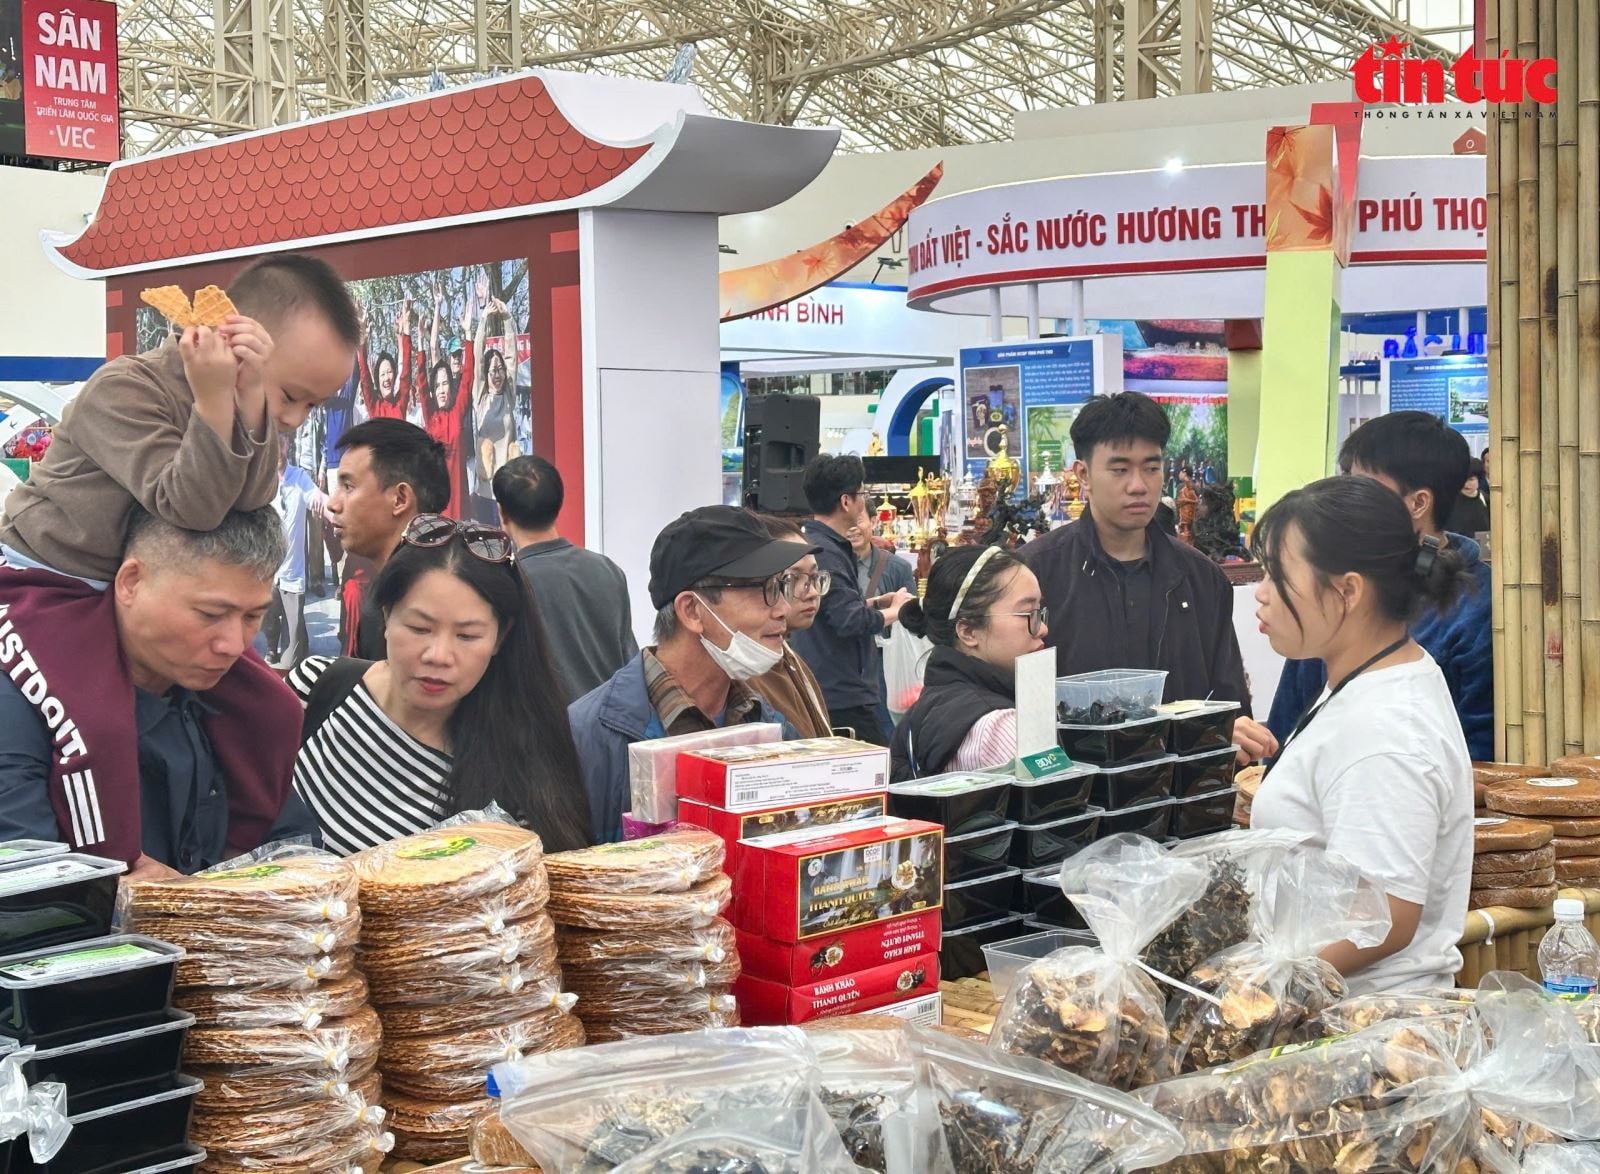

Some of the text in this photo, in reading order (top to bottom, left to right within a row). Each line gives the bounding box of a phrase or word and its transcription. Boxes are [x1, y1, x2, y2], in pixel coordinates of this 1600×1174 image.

[38, 8, 101, 51] SÂN
[35, 54, 107, 95] NAM
[53, 96, 79, 108] TRUNG
[55, 124, 96, 149] VEC
[941, 224, 971, 268] VIỆT
[987, 211, 1029, 256] SẮC
[1036, 208, 1107, 251] NƯỚC
[1117, 205, 1222, 245] HƯƠNG
[1358, 191, 1423, 233] PHÚ
[1433, 196, 1487, 238] THỌ
[797, 296, 844, 325] BÌNH
